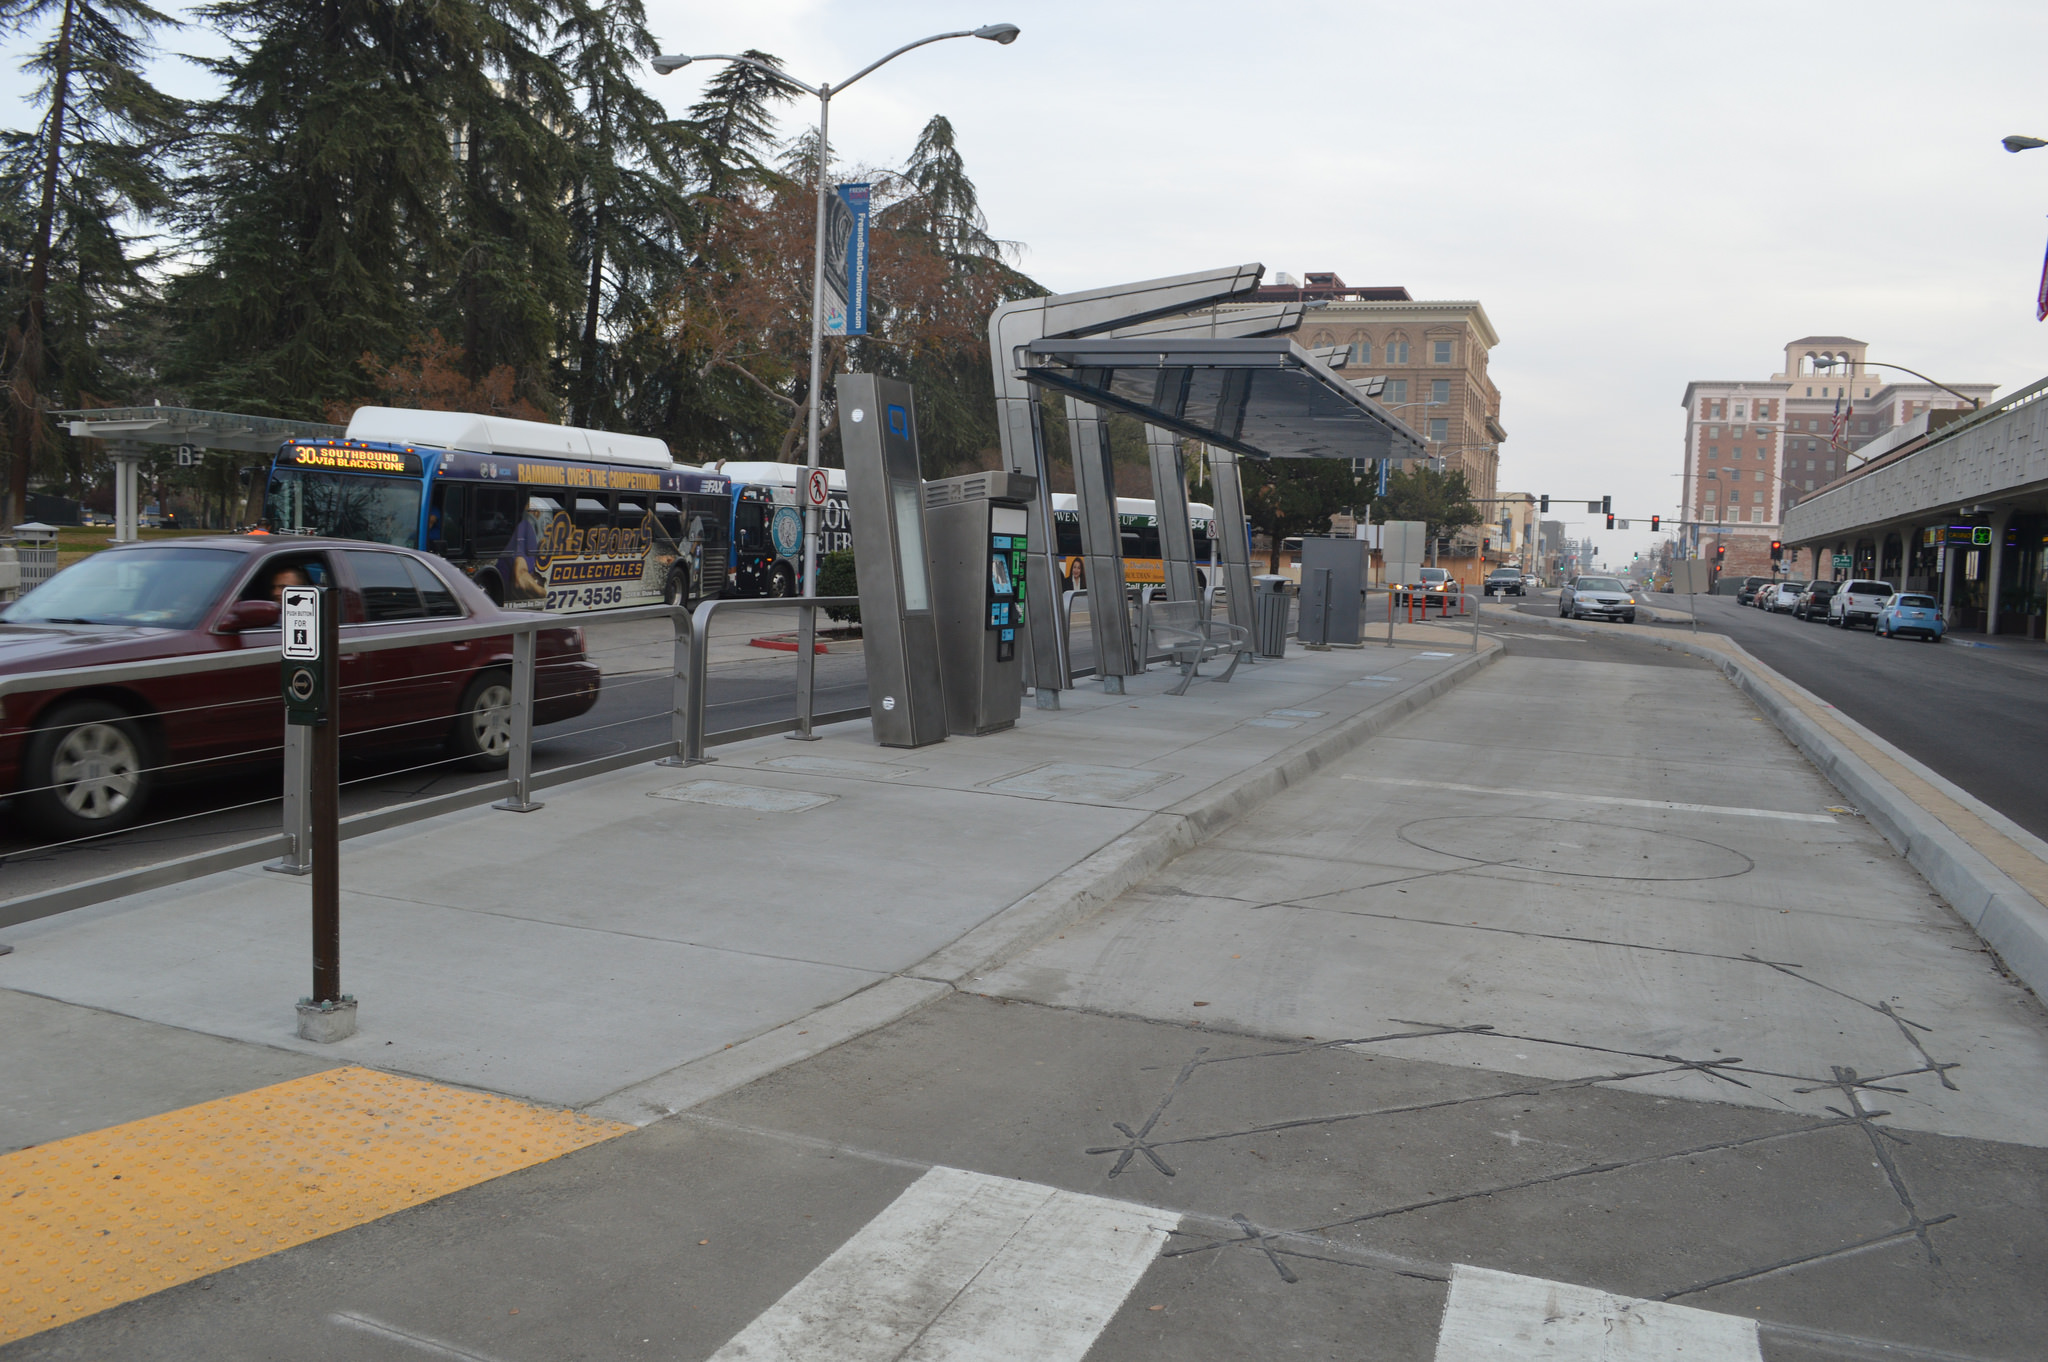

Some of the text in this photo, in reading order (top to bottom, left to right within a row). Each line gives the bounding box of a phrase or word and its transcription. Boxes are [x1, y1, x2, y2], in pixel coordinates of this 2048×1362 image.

[855, 213, 865, 329] FresnoStateDowntown.com
[179, 446, 192, 466] B
[296, 447, 316, 464] 30
[316, 457, 404, 472] VIA BLACKSTONE
[320, 448, 399, 462] SOUTHBOUND
[517, 463, 565, 485] RAMMING
[567, 468, 590, 487] OVER
[592, 470, 607, 488] THE
[609, 471, 661, 491] COMPETITION!
[707, 480, 725, 494] FAX
[552, 562, 643, 581] COLLECTIBLES
[545, 586, 622, 609] 277-3536
